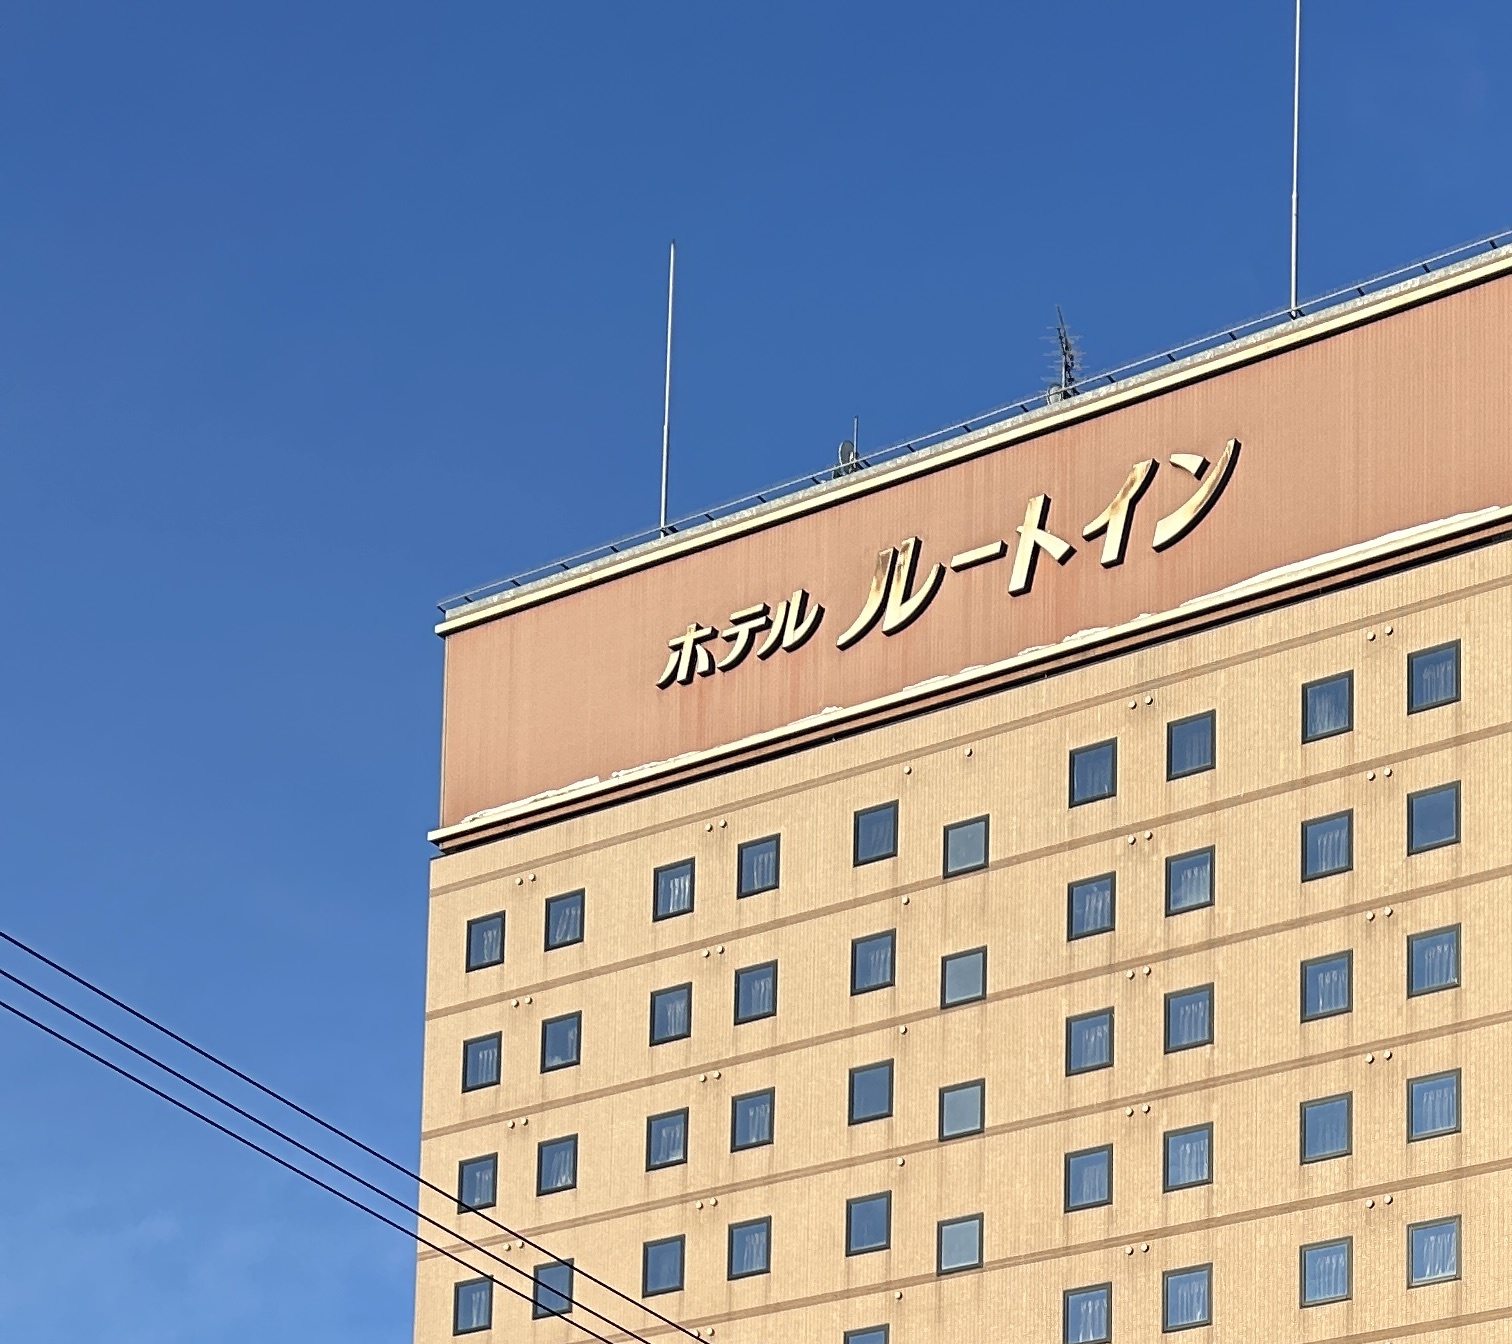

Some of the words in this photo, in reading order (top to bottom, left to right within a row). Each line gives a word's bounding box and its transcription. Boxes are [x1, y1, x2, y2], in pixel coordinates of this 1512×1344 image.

[656, 588, 824, 688] ホテル
[835, 437, 1242, 650] ルートイン
